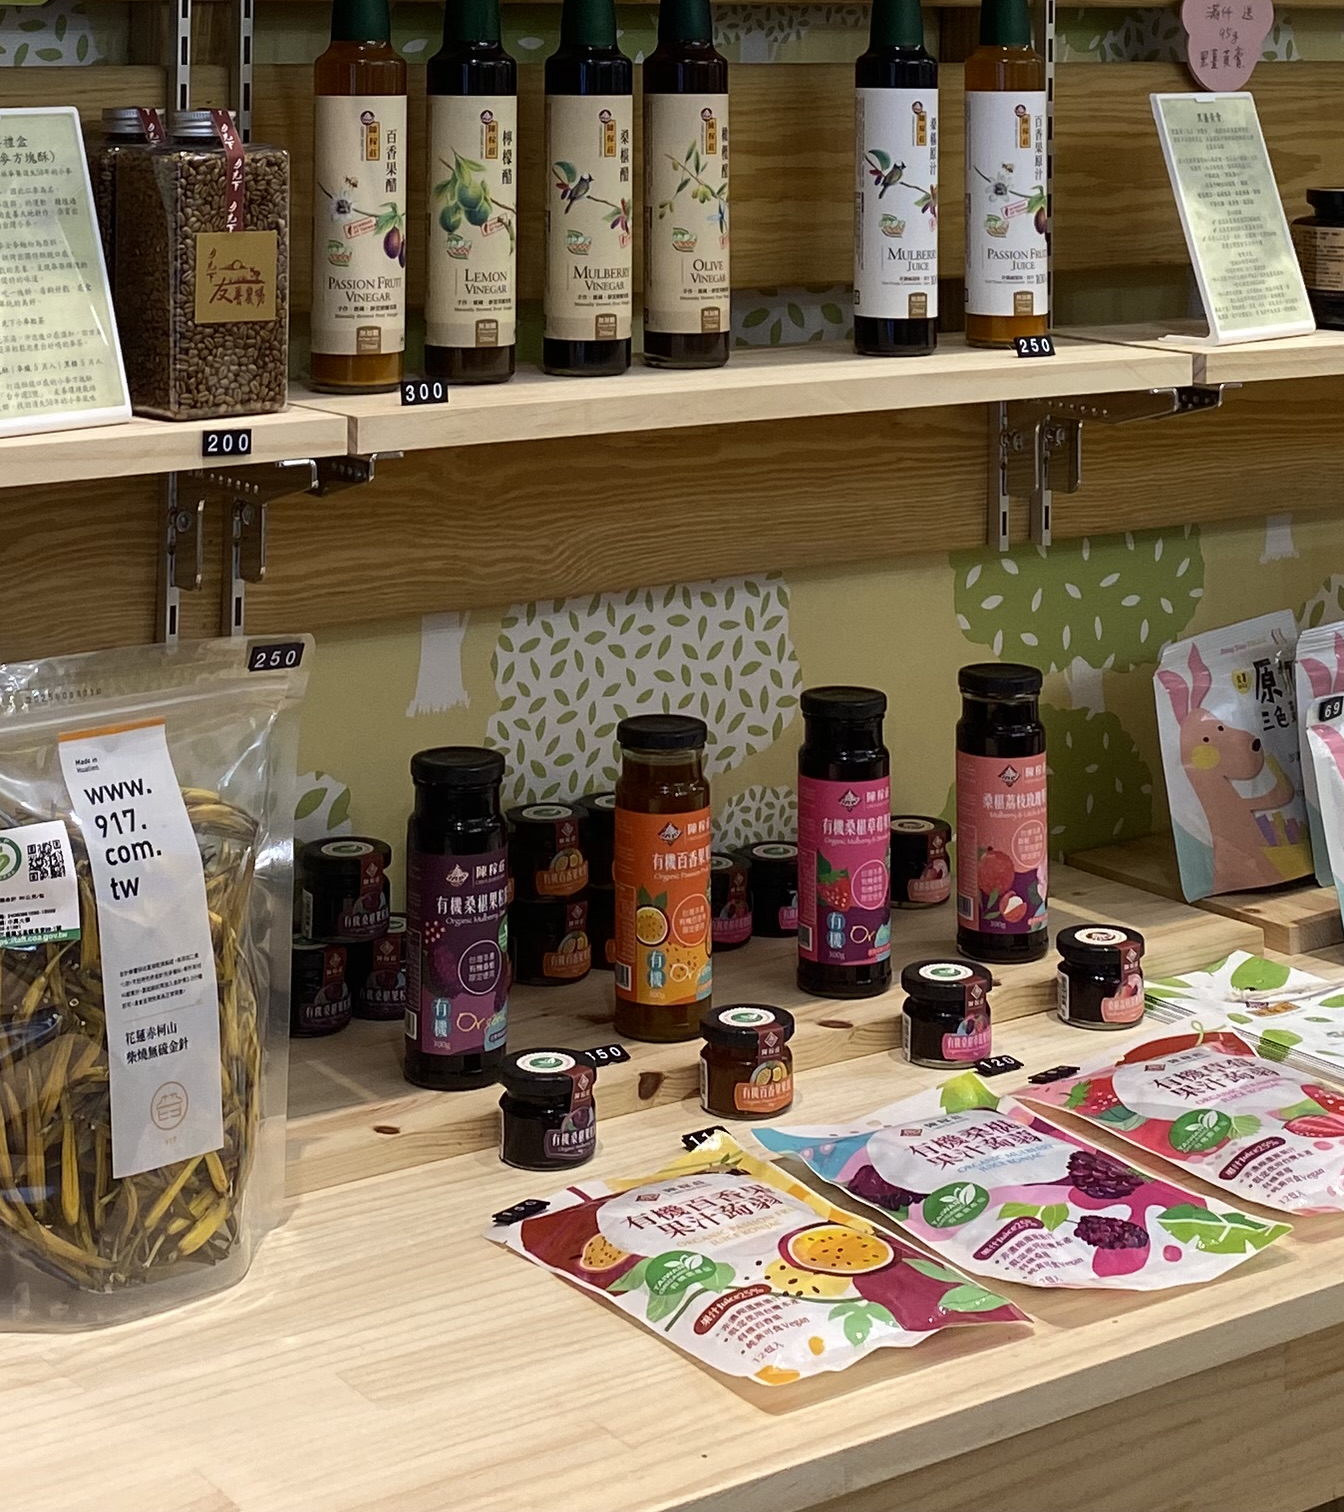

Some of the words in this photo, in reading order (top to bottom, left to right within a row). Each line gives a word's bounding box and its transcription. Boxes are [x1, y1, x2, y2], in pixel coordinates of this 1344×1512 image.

[385, 129, 397, 193] 百香果醋
[987, 248, 1028, 261] PASSION
[693, 259, 724, 272] OLIVE
[906, 260, 929, 271] JUICE
[1011, 259, 1035, 271] JUICE
[328, 276, 375, 290] PASSION
[464, 268, 507, 283] LEMON
[691, 271, 726, 284] VINEGAR
[464, 282, 507, 295] VINEGAR
[585, 280, 625, 292] VINEGAR
[345, 291, 391, 303] VINEGAR
[1019, 338, 1051, 353] 250
[406, 382, 443, 402] 300
[208, 434, 249, 453] 200
[255, 648, 296, 668] 250
[1324, 701, 1340, 718] 69
[83, 778, 152, 806] www.
[94, 807, 147, 838] 917.
[105, 837, 162, 867] com.
[110, 875, 140, 901] tw
[433, 998, 450, 1038] 有機
[979, 1055, 1015, 1071] 120
[656, 1192, 783, 1239] 果汁蒟蒻
